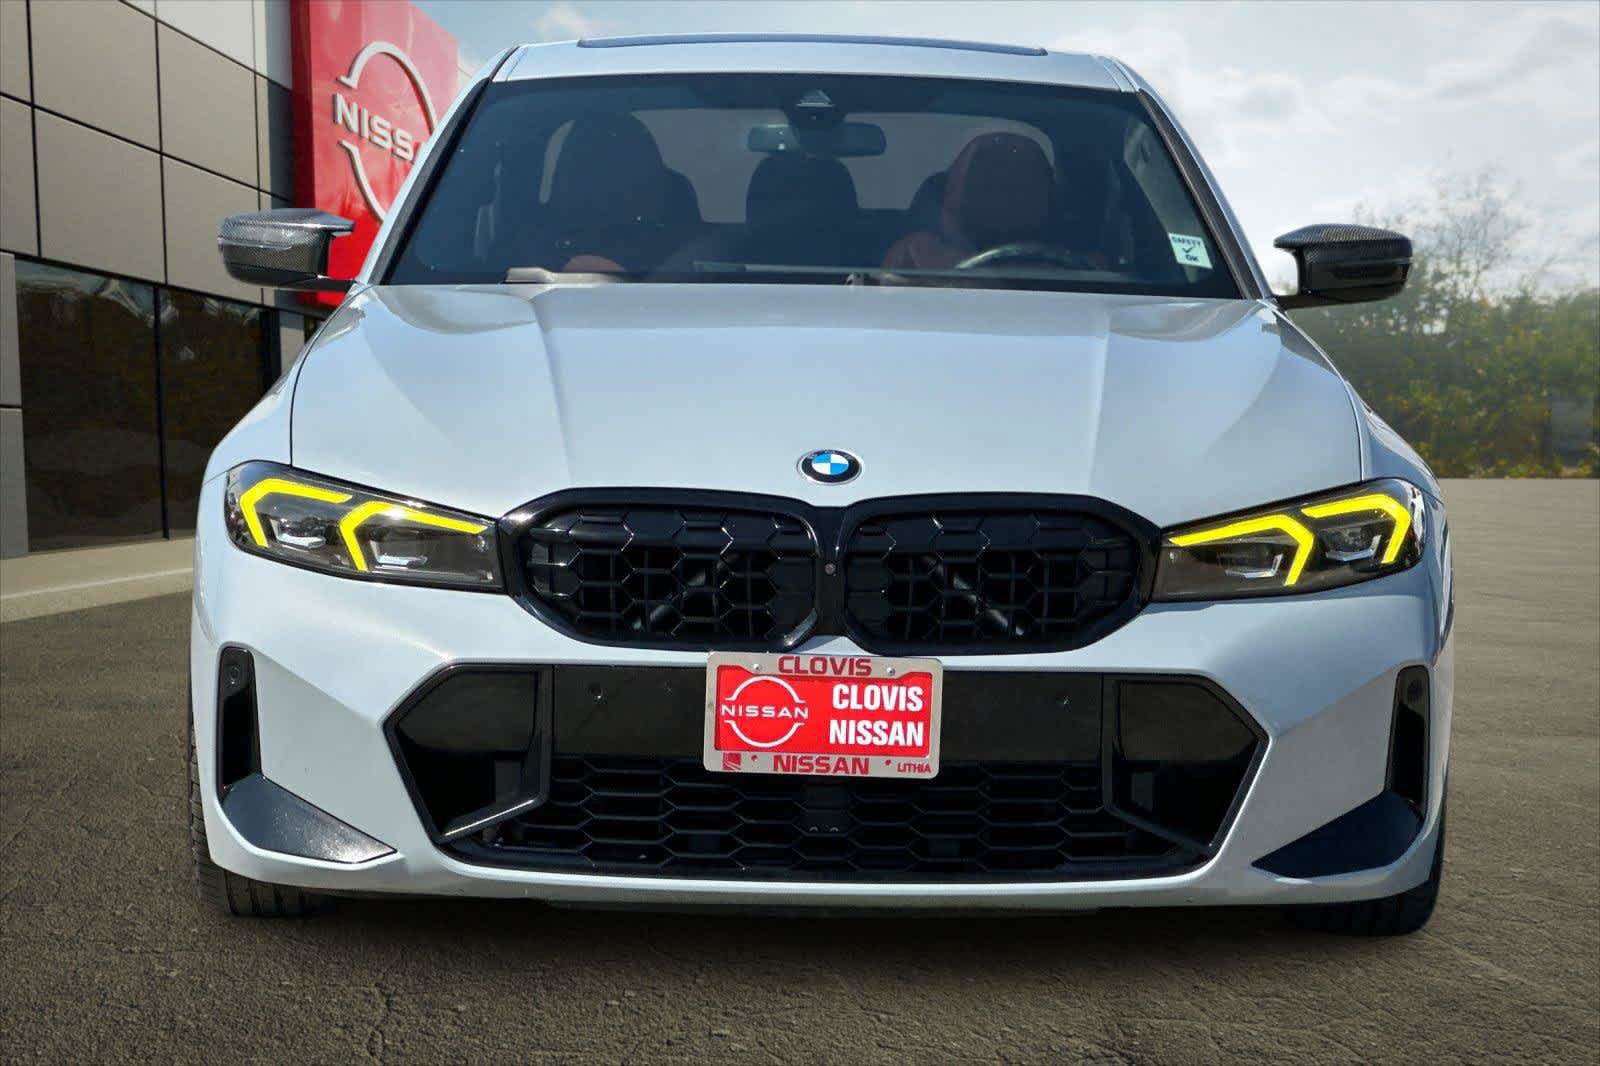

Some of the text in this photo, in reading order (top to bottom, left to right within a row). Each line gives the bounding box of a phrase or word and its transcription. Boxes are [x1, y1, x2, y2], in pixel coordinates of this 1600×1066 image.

[778, 655, 872, 676] CLOVIS
[832, 683, 923, 712] CLOVIS
[721, 704, 809, 719] NISSAN
[829, 719, 924, 747] NISSAN
[773, 754, 870, 775] NISSAN
[897, 762, 931, 773] LITHIA
